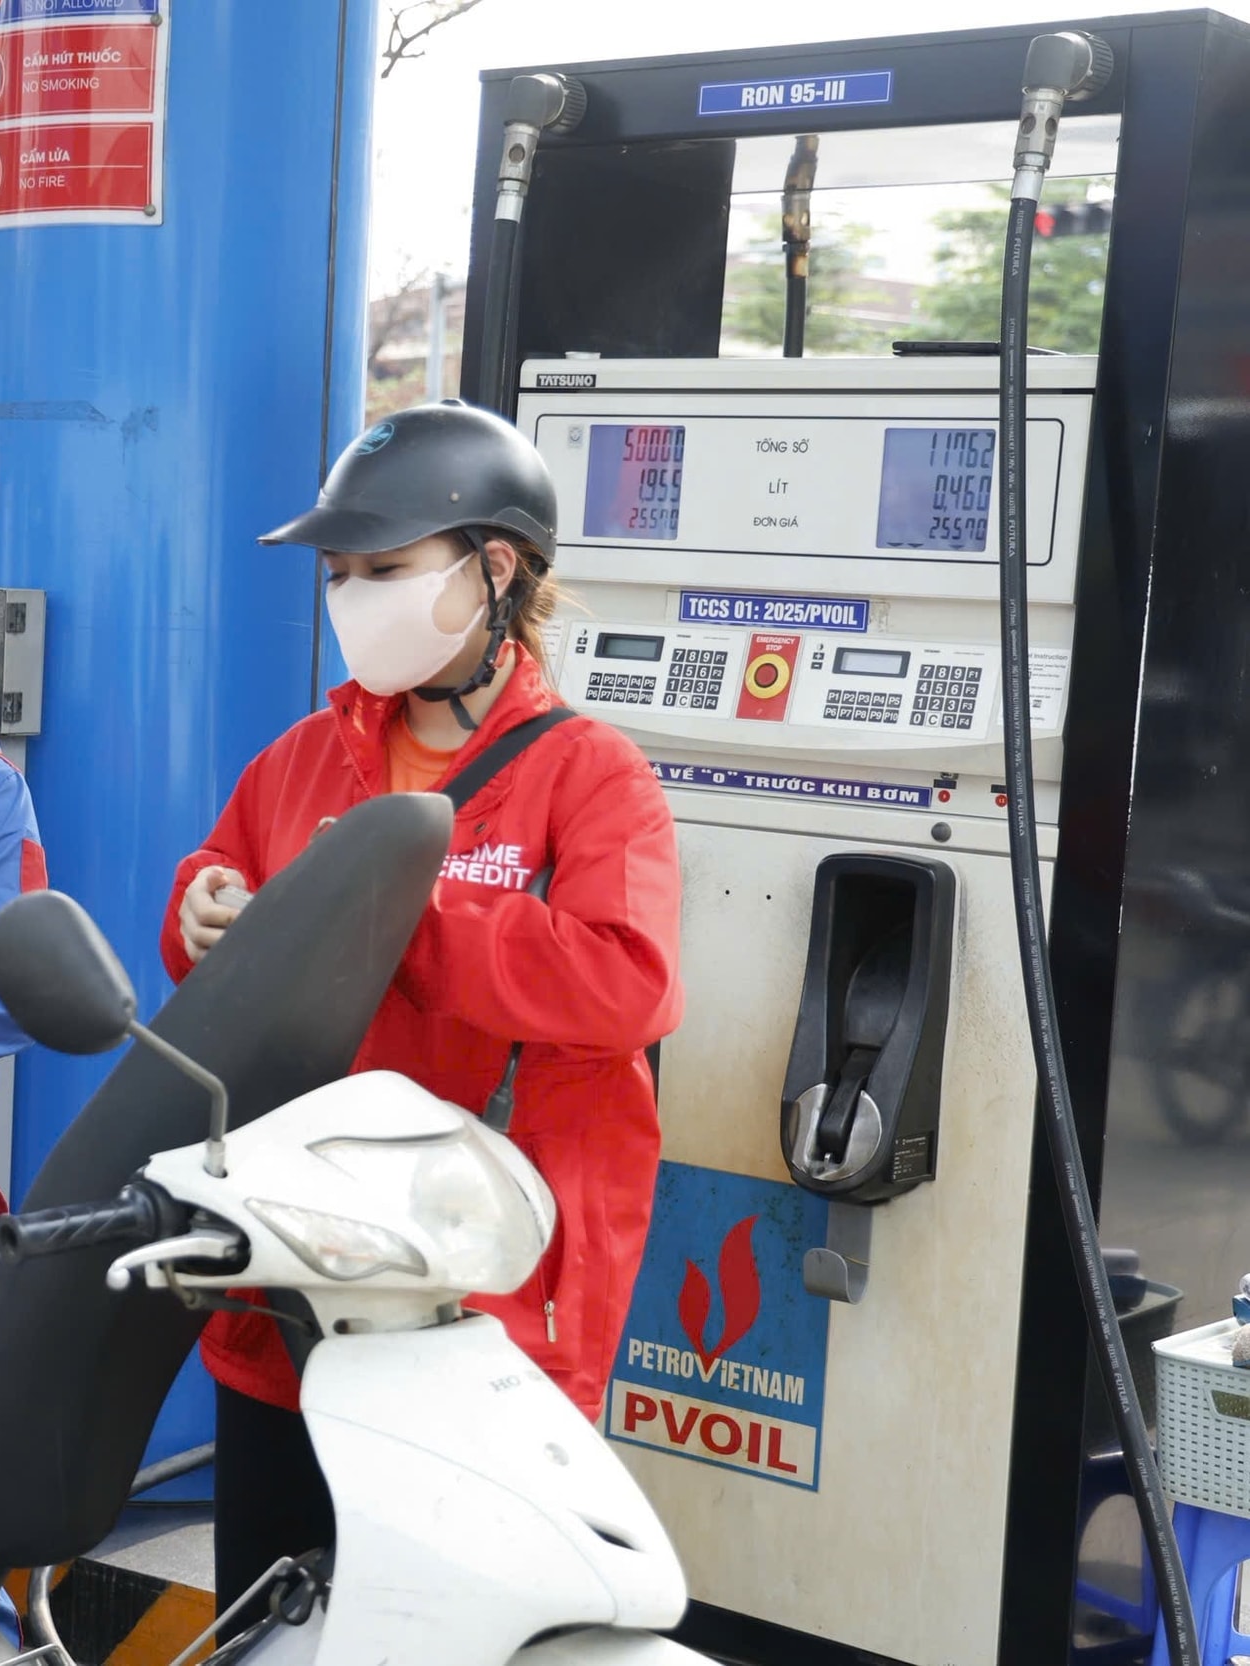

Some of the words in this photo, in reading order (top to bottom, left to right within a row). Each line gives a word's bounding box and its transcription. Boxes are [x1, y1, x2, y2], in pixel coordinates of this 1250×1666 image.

[23, 50, 48, 67] CẤM
[77, 47, 121, 63] THUỐC
[23, 80, 38, 93] NO
[41, 77, 100, 91] SMOKING
[741, 85, 784, 107] RON
[790, 80, 846, 104] 95-III
[20, 148, 45, 163] CẤM
[19, 177, 35, 189] NO
[38, 175, 65, 188] FIRE
[538, 374, 594, 387] TATSUNO
[623, 428, 686, 462] 50000
[930, 431, 996, 468] 11762
[768, 478, 789, 494] LÍT
[933, 474, 992, 512] 0,460
[628, 508, 680, 530] 25570
[780, 515, 799, 527] GIÁ
[929, 516, 987, 541] 25570
[689, 598, 730, 618] TCCS
[734, 601, 759, 620] 01:
[763, 602, 857, 625] 2025/PVOIL
[675, 651, 684, 660] 7
[689, 652, 695, 661] 8
[703, 652, 710, 662] 9
[672, 665, 679, 675] 4
[686, 666, 693, 676] 5
[700, 667, 707, 677] 6
[924, 667, 933, 677] 7
[938, 668, 946, 678] 8
[954, 668, 962, 679] 9
[670, 680, 675, 689] 1
[683, 681, 690, 691] 2
[696, 682, 704, 692] 3
[919, 682, 927, 693] 4
[935, 683, 943, 693] 5
[951, 684, 958, 694] 6
[666, 695, 672, 705] 0
[679, 696, 687, 705] C
[918, 698, 923, 708] 1
[932, 699, 940, 710] 2
[947, 700, 955, 711] 3
[913, 714, 921, 724] 0
[928, 714, 938, 725] C
[669, 765, 694, 780] VỀ
[744, 774, 815, 792] TRƯỚC
[822, 782, 860, 797] KHI
[867, 787, 919, 803] BƠM
[628, 1338, 804, 1405] PETROVIETNAM
[624, 1391, 798, 1474] PVOIL
